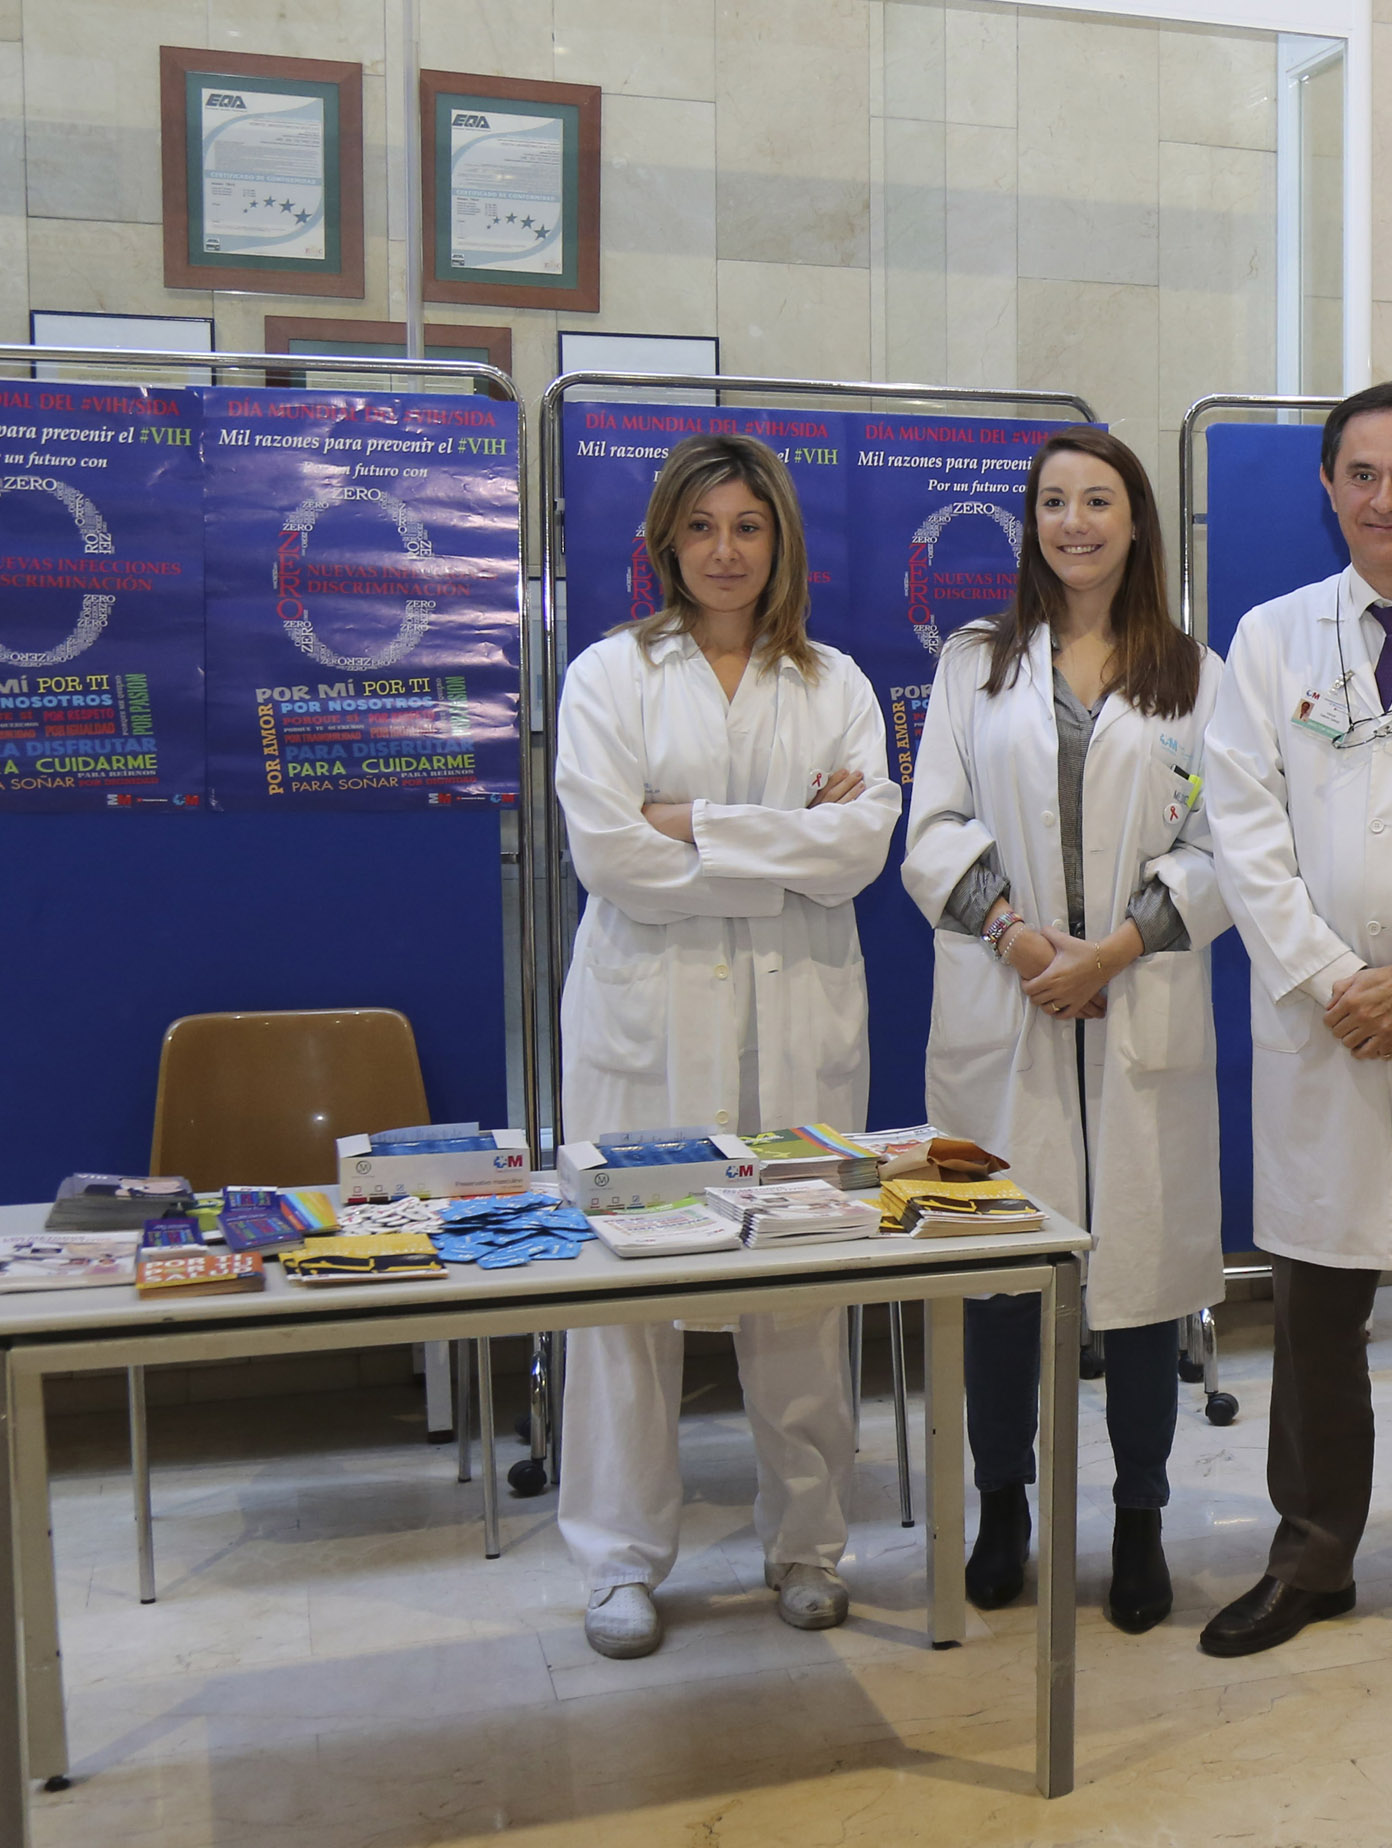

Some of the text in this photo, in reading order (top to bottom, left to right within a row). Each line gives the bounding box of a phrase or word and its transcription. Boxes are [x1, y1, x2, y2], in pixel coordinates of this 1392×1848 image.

[205, 94, 247, 109] EQA
[452, 114, 491, 129] EQA
[40, 394, 74, 411] DEL
[81, 397, 180, 416] #VIH/SIDA
[228, 400, 262, 417] DÍA
[268, 403, 358, 421] MUNDIAL
[586, 411, 828, 437] DÍA MUNDIAL DEL #VIH/SIDA
[865, 421, 1007, 443] DÍA MUNDIAL DEL
[41, 426, 115, 444] prevenir
[118, 427, 134, 443] el
[140, 427, 192, 446] #VIH
[219, 429, 506, 455] Mil razones para prevenir el #VIH
[4, 452, 108, 468] un futuro con
[578, 441, 606, 457] Mil
[610, 444, 668, 459] razones
[794, 448, 838, 465] #VIH
[858, 451, 1032, 473] Mil razones para preveni
[353, 463, 399, 479] futuro
[403, 467, 428, 478] con
[3, 476, 57, 491] ZERO
[928, 479, 1026, 495] Por un futuro co
[331, 488, 381, 500] ZERO
[953, 503, 995, 514] ZERO
[283, 523, 313, 531] ZERO
[58, 558, 182, 575] INFECCIONES
[307, 564, 377, 578] NUEVAS
[0, 574, 152, 591] SCRIMINACIÓN
[307, 579, 471, 596] DISCRIMINACIÓN
[934, 573, 993, 585] NUEVAS
[37, 676, 82, 693] POR
[86, 674, 110, 690] TI
[256, 685, 314, 703] POR
[364, 680, 405, 695] POR
[409, 678, 431, 692] TI
[1, 694, 113, 708] NOSOTROS
[125, 673, 154, 735] POR PASION
[281, 697, 432, 713] POR NOSOTROS
[26, 738, 157, 756] DISFRUTAR
[258, 703, 284, 795] POR AMOR
[286, 738, 475, 760] PARA DISFRUTAR
[892, 700, 914, 785] POR AMOR
[36, 754, 157, 773] CUIDARME
[288, 754, 475, 777] PARA CUIDARME
[11, 775, 75, 790] SOÑAR
[292, 776, 398, 792] PARA SOÑAR
[145, 1257, 205, 1269] POR
